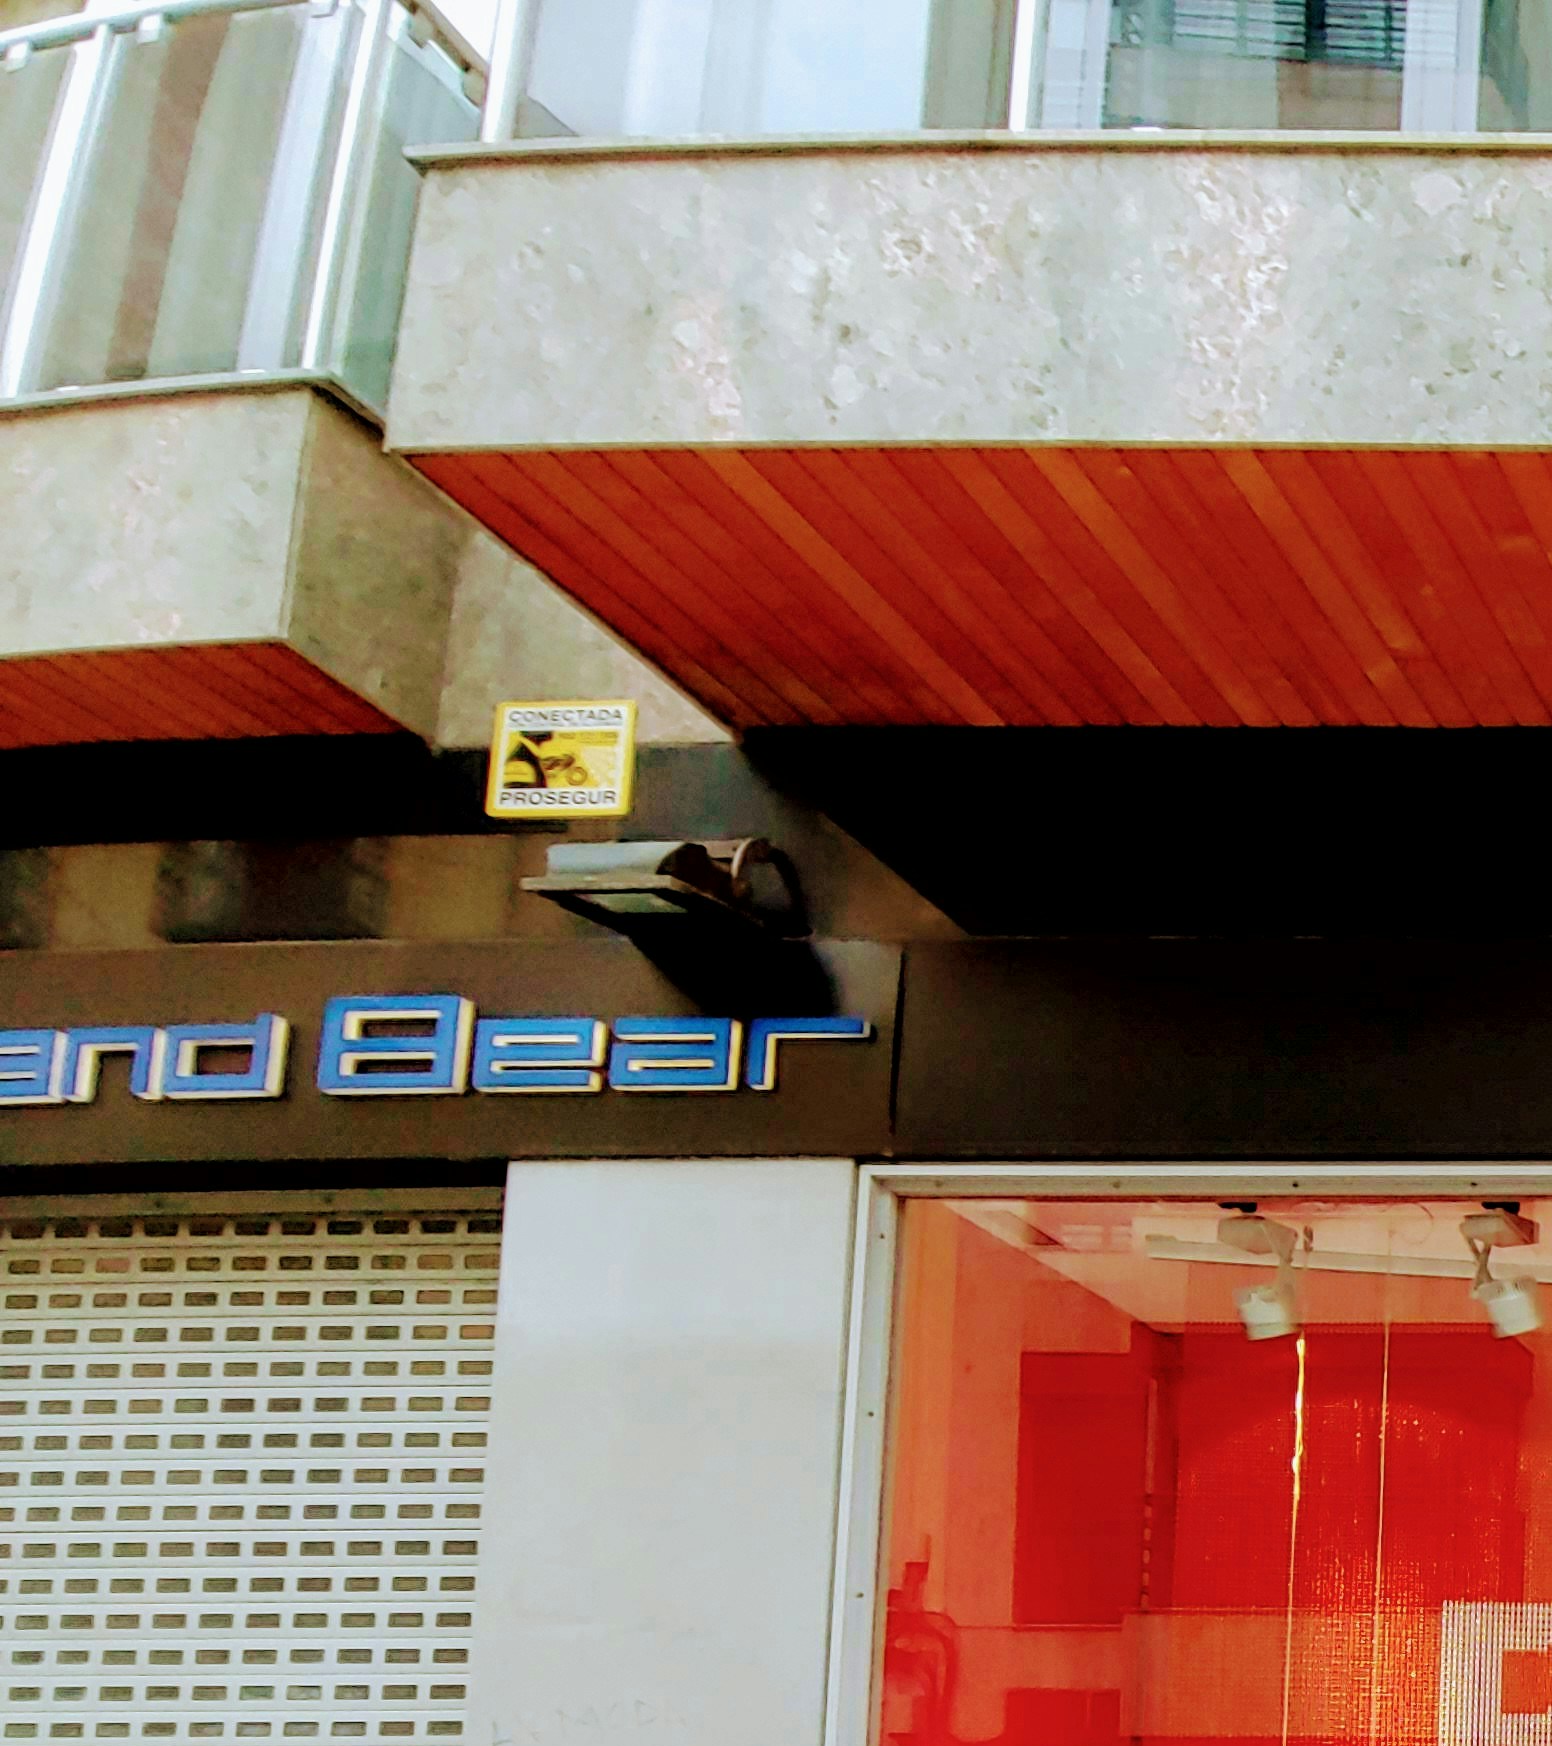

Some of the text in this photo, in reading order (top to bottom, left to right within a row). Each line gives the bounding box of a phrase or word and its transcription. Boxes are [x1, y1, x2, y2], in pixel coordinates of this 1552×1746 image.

[508, 709, 623, 722] CONECTADA
[500, 791, 617, 805] PROSEGUR
[316, 994, 876, 1096] Bear
